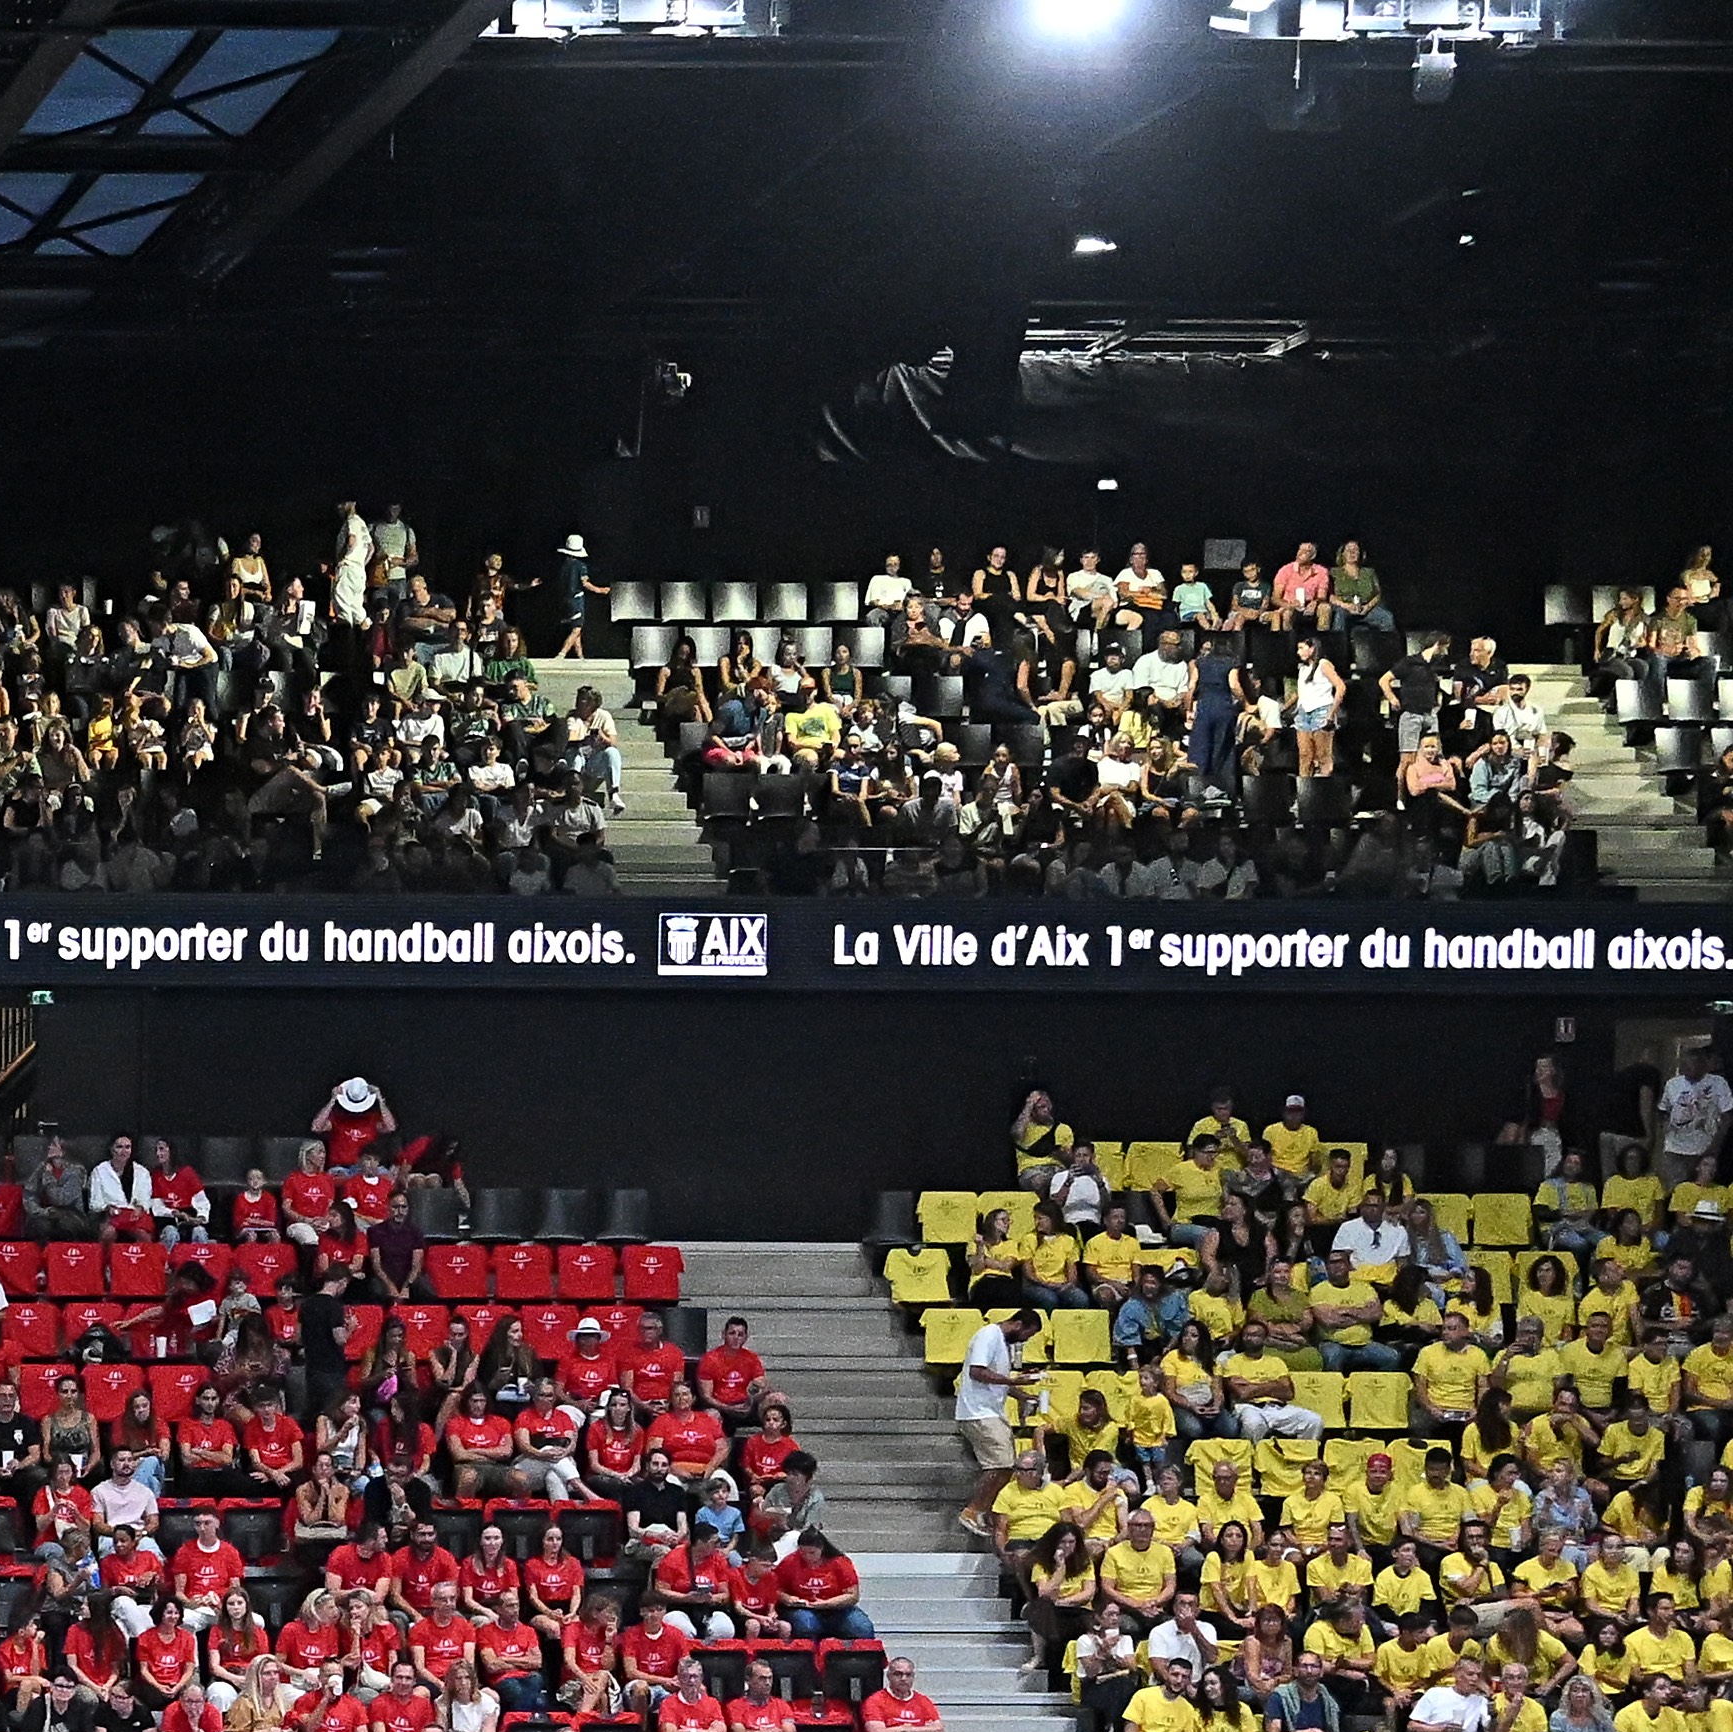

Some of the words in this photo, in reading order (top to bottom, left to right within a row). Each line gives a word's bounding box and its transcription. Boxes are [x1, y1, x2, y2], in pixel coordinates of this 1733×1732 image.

[59, 923, 248, 969] supporter
[260, 921, 308, 961] du
[325, 921, 493, 962] handball
[508, 923, 635, 963] aixois.
[701, 917, 764, 955] AIX
[834, 925, 878, 965] La
[893, 925, 977, 965] Ville
[991, 925, 1089, 966] d'Aix
[1160, 929, 1349, 974] supporter
[1360, 928, 1410, 968] du
[1424, 928, 1594, 969] handball
